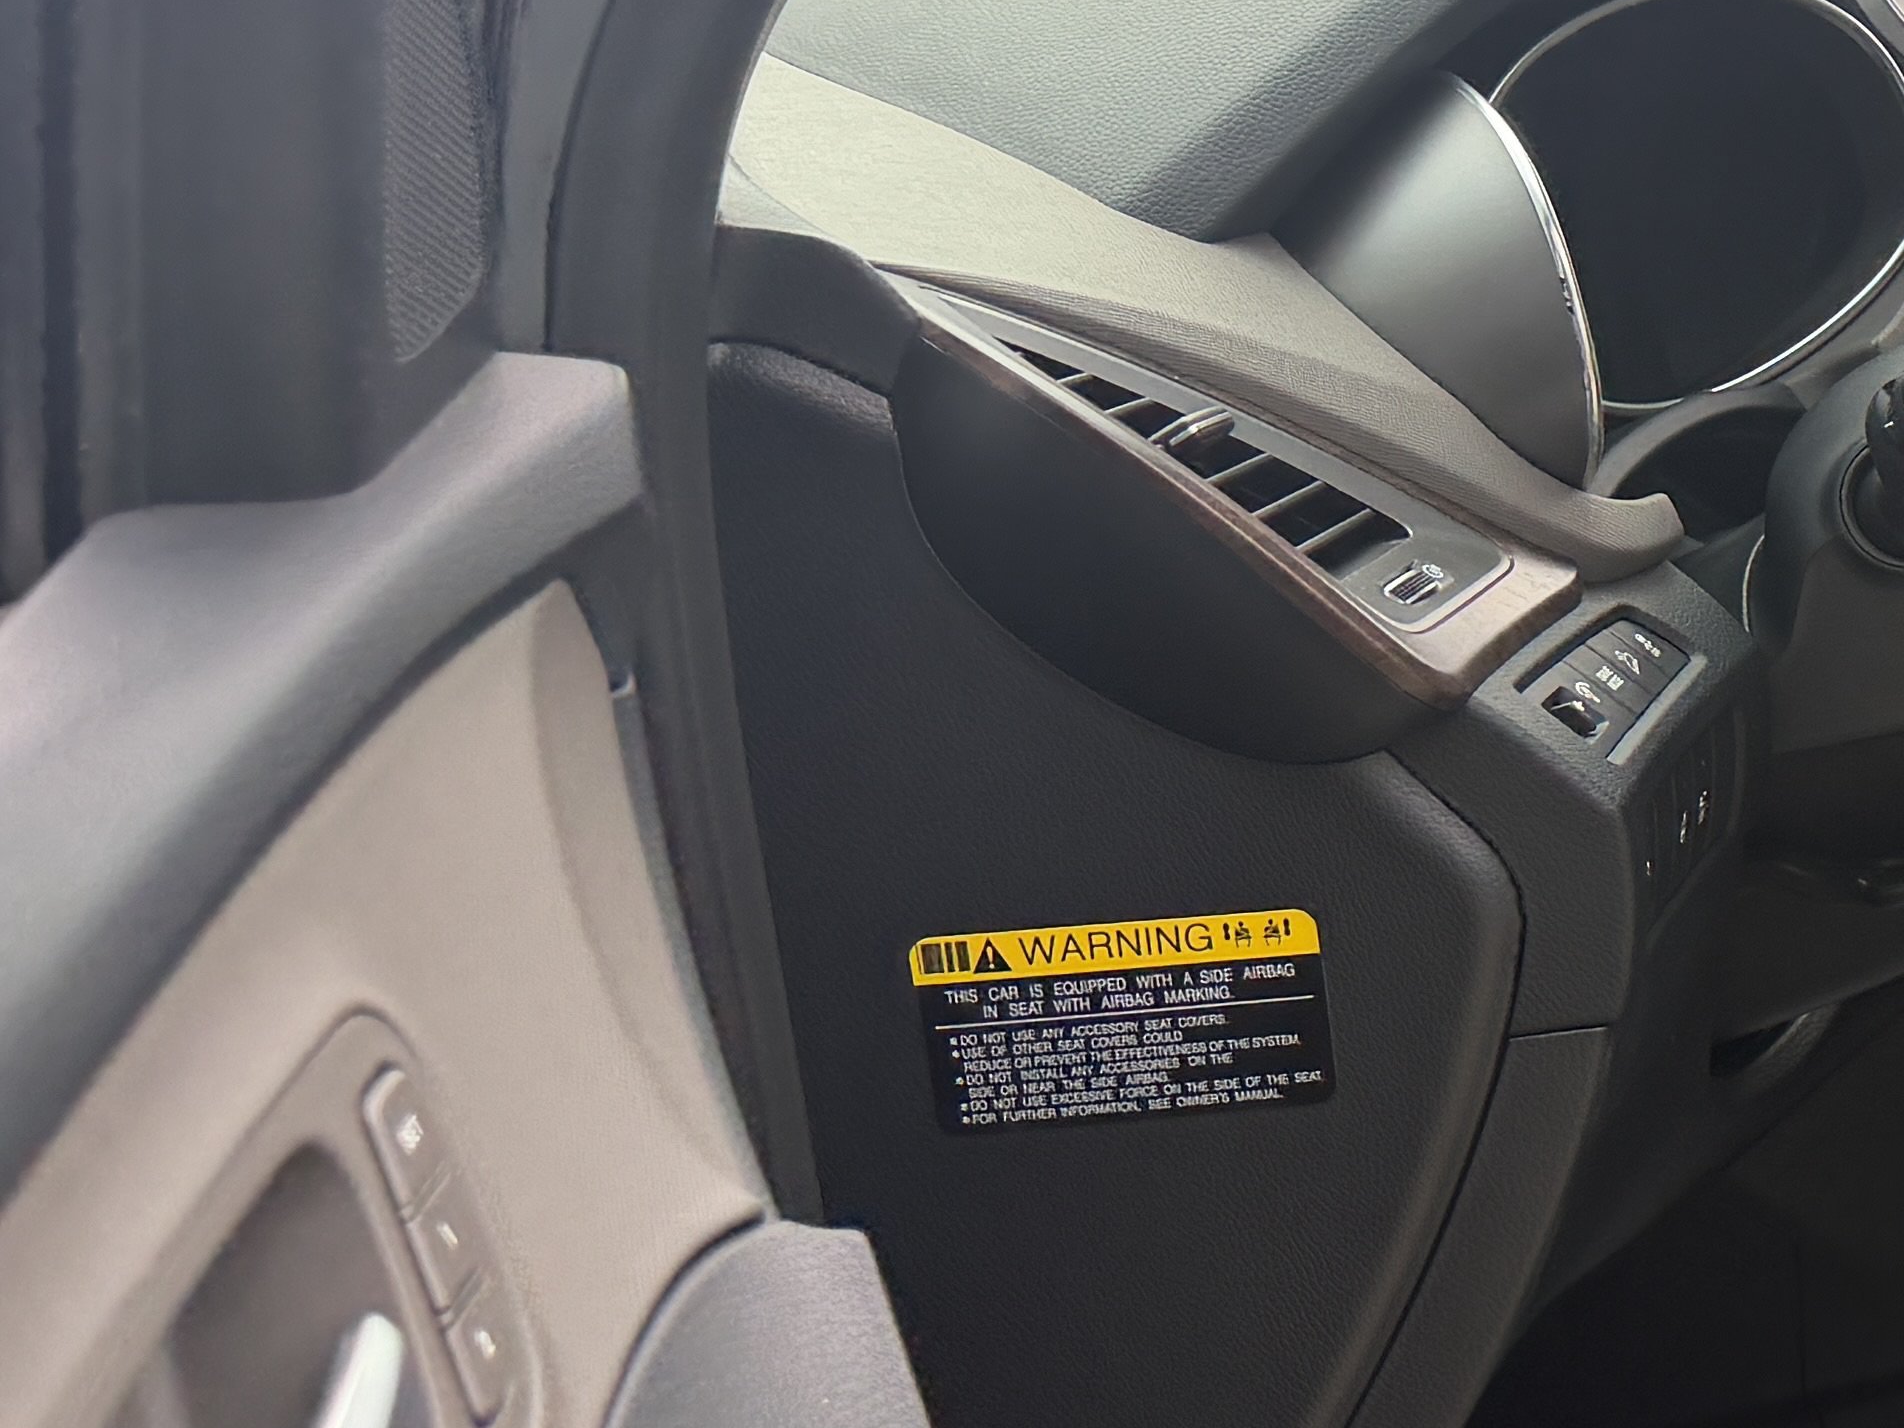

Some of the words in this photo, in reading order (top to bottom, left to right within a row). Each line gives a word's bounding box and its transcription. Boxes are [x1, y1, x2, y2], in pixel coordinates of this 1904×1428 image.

[1018, 924, 1213, 965] WARNING
[944, 989, 978, 1004] THIS
[989, 986, 1019, 1001] CAR
[1030, 984, 1043, 998] IS
[1054, 978, 1126, 996] EQUIPPED
[1136, 974, 1172, 990] WITH
[1184, 972, 1193, 985] A
[1200, 968, 1232, 984] SIDE
[1243, 963, 1295, 980] AIRBAG
[983, 1005, 997, 1019] IN
[1009, 1000, 1044, 1017] SEAT
[1053, 996, 1090, 1013] WITH
[1101, 992, 1154, 1009] AIRBAG
[1164, 986, 1235, 1004] MARKING.
[960, 1034, 977, 1046] DO
[983, 1032, 1006, 1043] NOT
[1012, 1029, 1035, 1041] USE
[1042, 1027, 1064, 1039] ANY
[1071, 1021, 1138, 1037] ACCESSORY
[1144, 1018, 1172, 1031] SEAT
[961, 1047, 986, 1059] USE
[991, 1045, 1008, 1056] OF
[1013, 1041, 1052, 1055] OTHER
[1057, 1038, 1086, 1051] SEAT
[1091, 1034, 1138, 1049] COVERS
[1143, 1031, 1182, 1044] COULD
[964, 1058, 1012, 1073] REDUCE
[1015, 1057, 1032, 1068] OR
[1034, 1052, 1087, 1067] PREVENT
[1091, 1049, 1114, 1061] THE
[1115, 1040, 1207, 1061] EFFECTIVENESS
[1209, 1040, 1226, 1052] OF
[1227, 1037, 1250, 1050] THE
[966, 1074, 984, 1086] DO
[989, 1072, 1012, 1084] NOT
[1021, 1067, 1068, 1081] INSTALL
[1071, 1066, 1094, 1077] ANY
[1100, 1056, 1180, 1074] ACCESSORIES
[1188, 1055, 1207, 1067] ON
[1211, 1052, 1234, 1064] THE
[968, 1085, 995, 1099] SIDE
[1001, 1084, 1018, 1095] OR
[1023, 1080, 1056, 1094] NEAR
[1065, 1079, 1085, 1090] THE
[1091, 1076, 1118, 1088] SIDE
[970, 1100, 988, 1111] DO
[994, 1098, 1018, 1109] NOT
[1023, 1095, 1048, 1107] USE
[1051, 1089, 1116, 1104] EXCESSIVE
[1119, 1085, 1160, 1098] FORCE
[1164, 1084, 1182, 1096] ON
[1186, 1081, 1210, 1093] THE
[1214, 1078, 1242, 1090] SIDE
[1245, 1077, 1261, 1087] OF
[1267, 1074, 1290, 1085] THE
[972, 1111, 998, 1124] FOR
[1003, 1108, 1057, 1122] FURTHER
[1149, 1098, 1171, 1110] SEE
